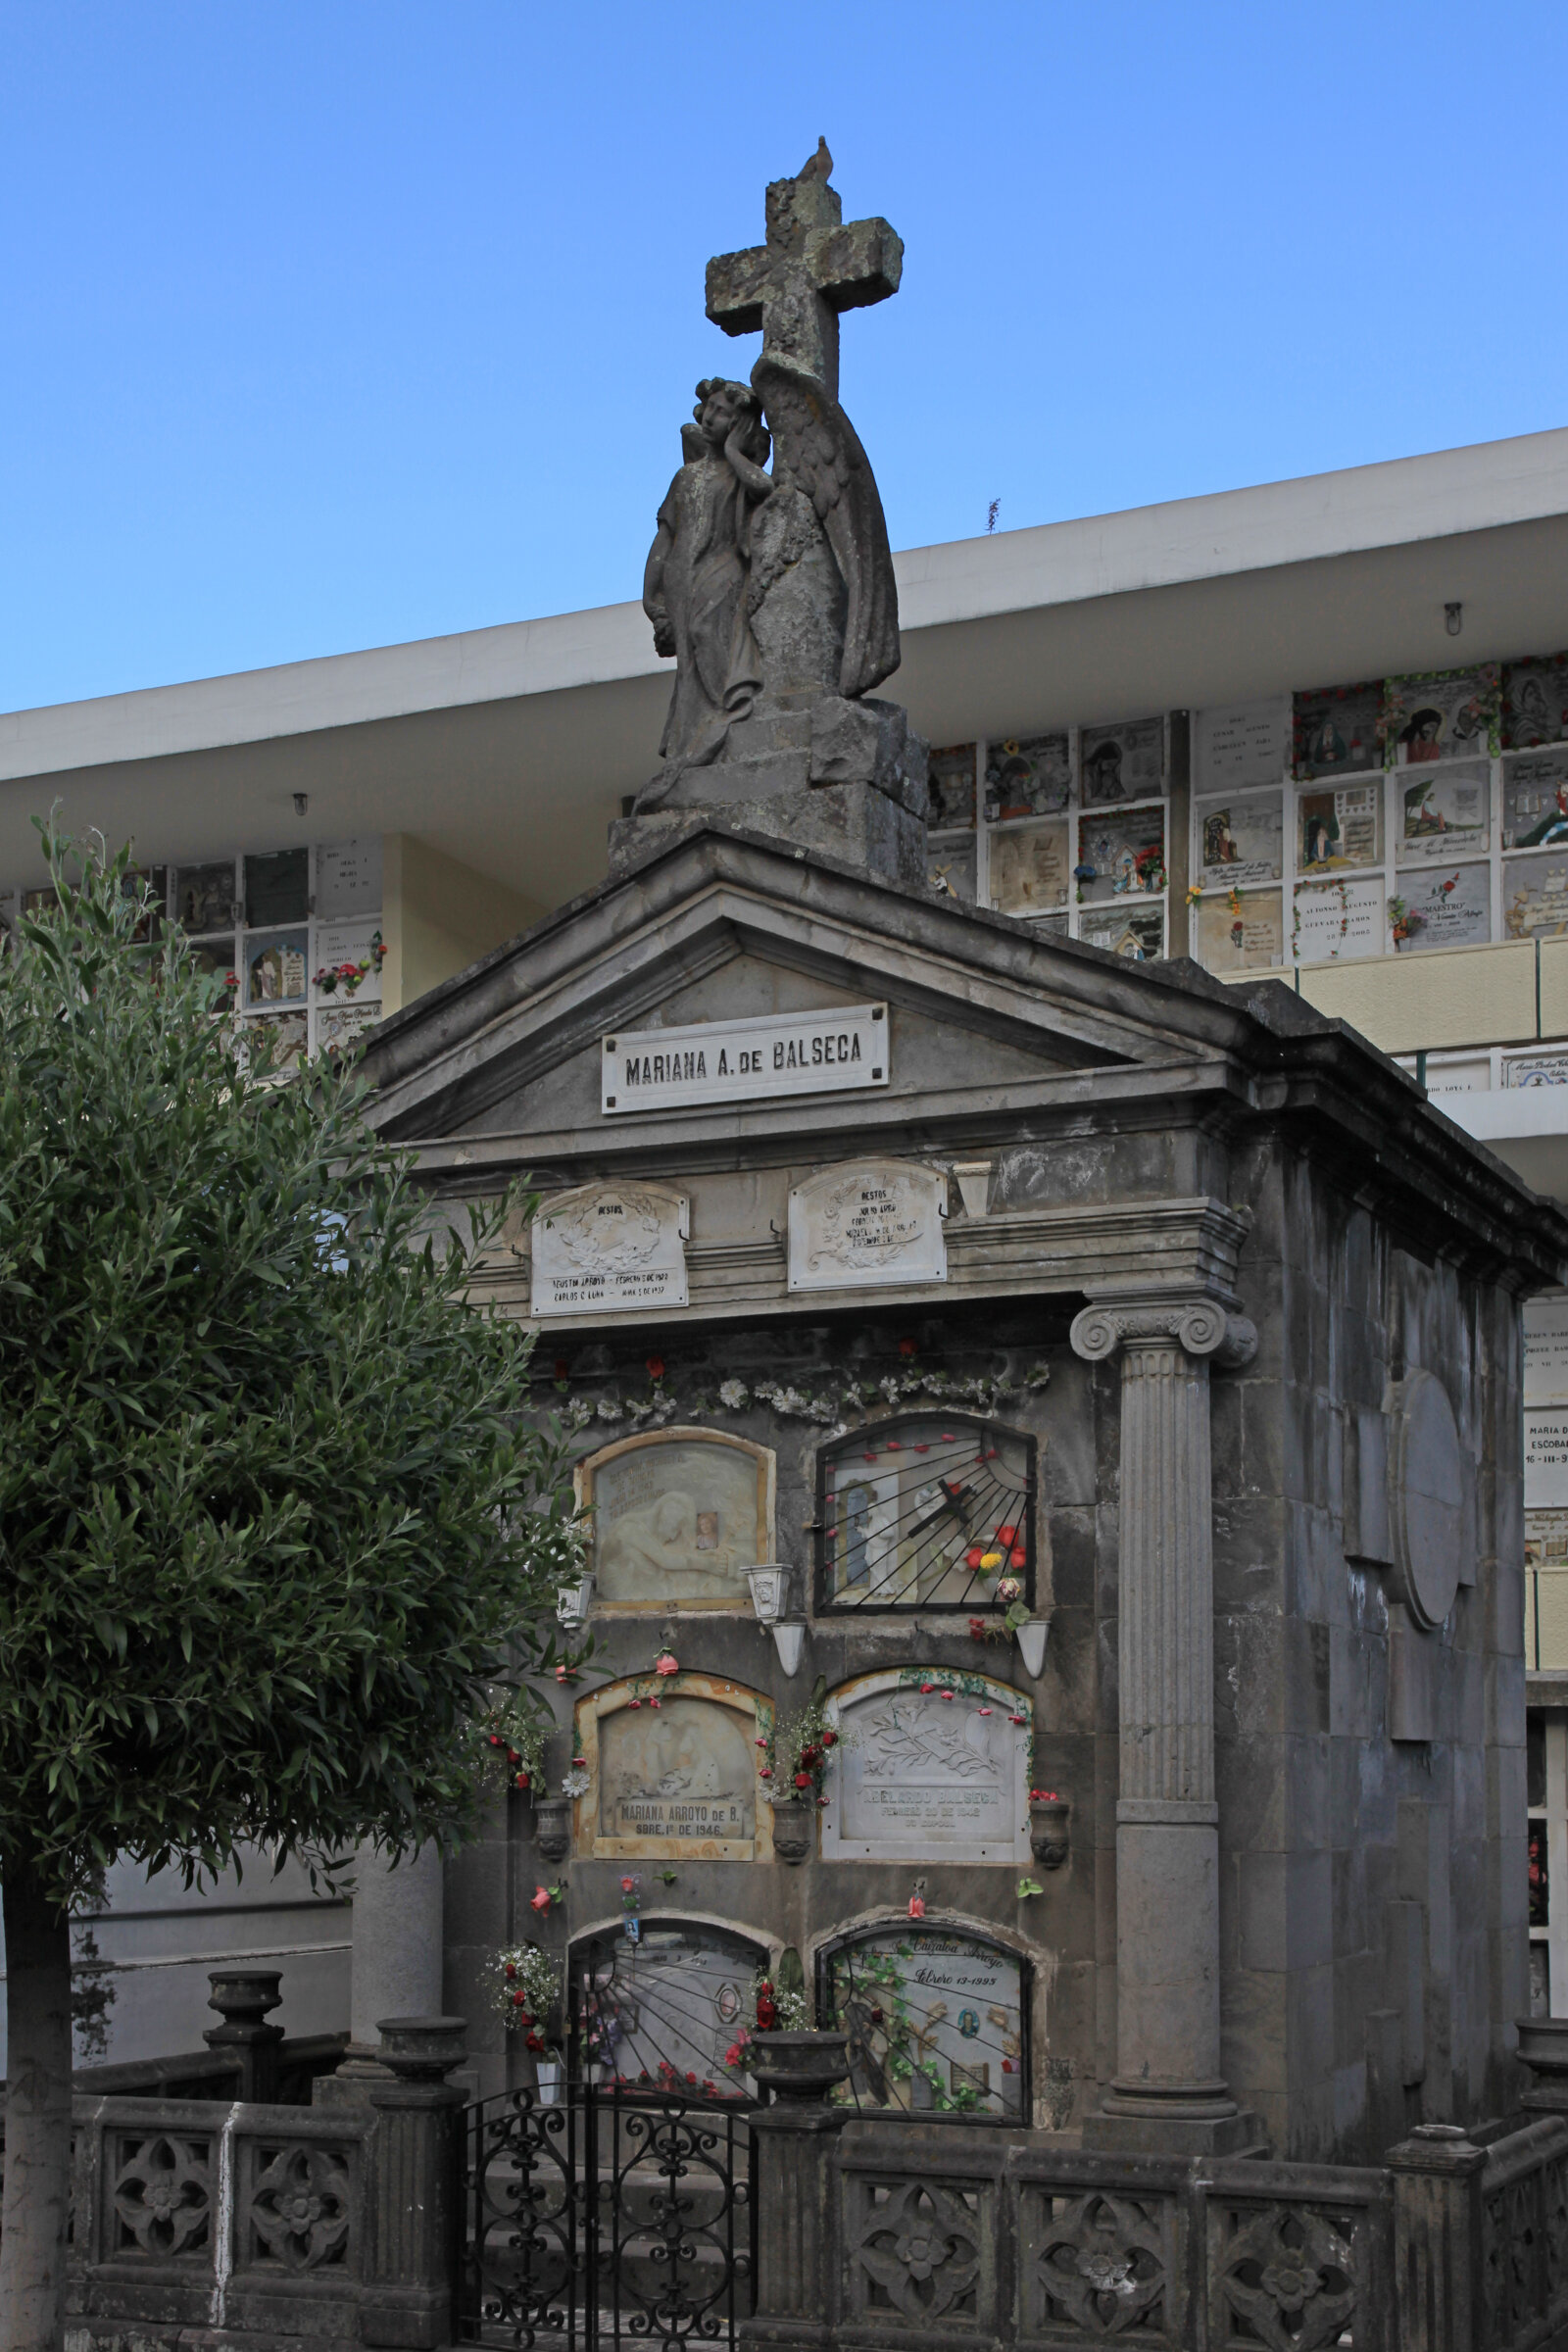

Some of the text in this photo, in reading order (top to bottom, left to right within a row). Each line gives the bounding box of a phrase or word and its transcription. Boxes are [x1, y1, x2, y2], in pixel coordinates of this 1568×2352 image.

[626, 1032, 862, 1086] MARIANA A. DE BALSECA
[555, 1292, 578, 1302] CARLOS
[1530, 1426, 1559, 1435] MARIA
[862, 1789, 999, 1804] ABELARDO BALSECA
[620, 1803, 664, 1822] MARIANA
[668, 1805, 708, 1822] ARROYO
[730, 1805, 741, 1823] B.
[881, 1805, 922, 1817] FEBRERO
[678, 1824, 692, 1836] DE
[912, 1966, 997, 1986] Febrero 13-1995
